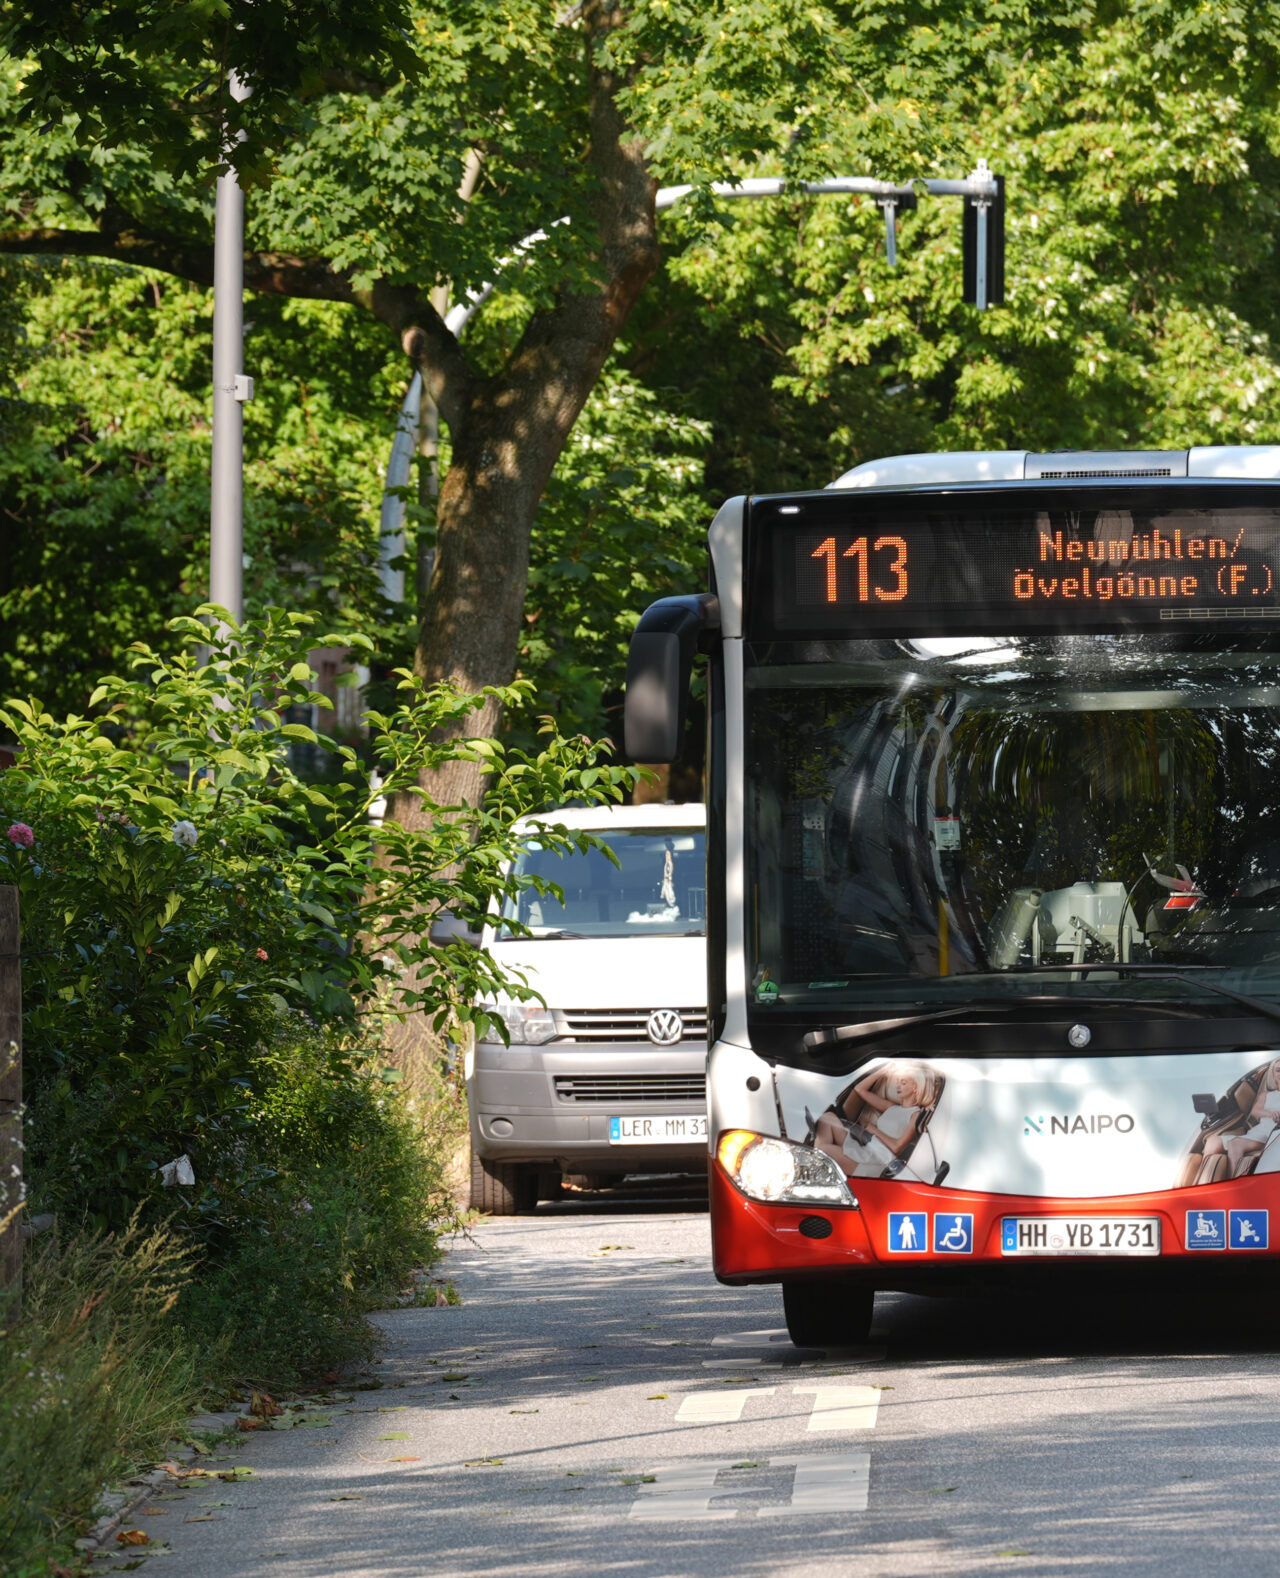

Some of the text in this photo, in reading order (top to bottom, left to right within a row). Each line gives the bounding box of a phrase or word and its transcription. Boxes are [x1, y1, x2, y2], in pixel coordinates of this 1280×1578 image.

[1039, 528, 1245, 561] Neumühlen/
[810, 536, 908, 602] 113
[1014, 564, 1272, 600] Övelgönne (F.)
[622, 1119, 653, 1136] LER
[665, 1119, 686, 1136] MM
[1050, 1113, 1135, 1135] NAIPO
[1006, 1223, 1154, 1247] D HH YB 1731
